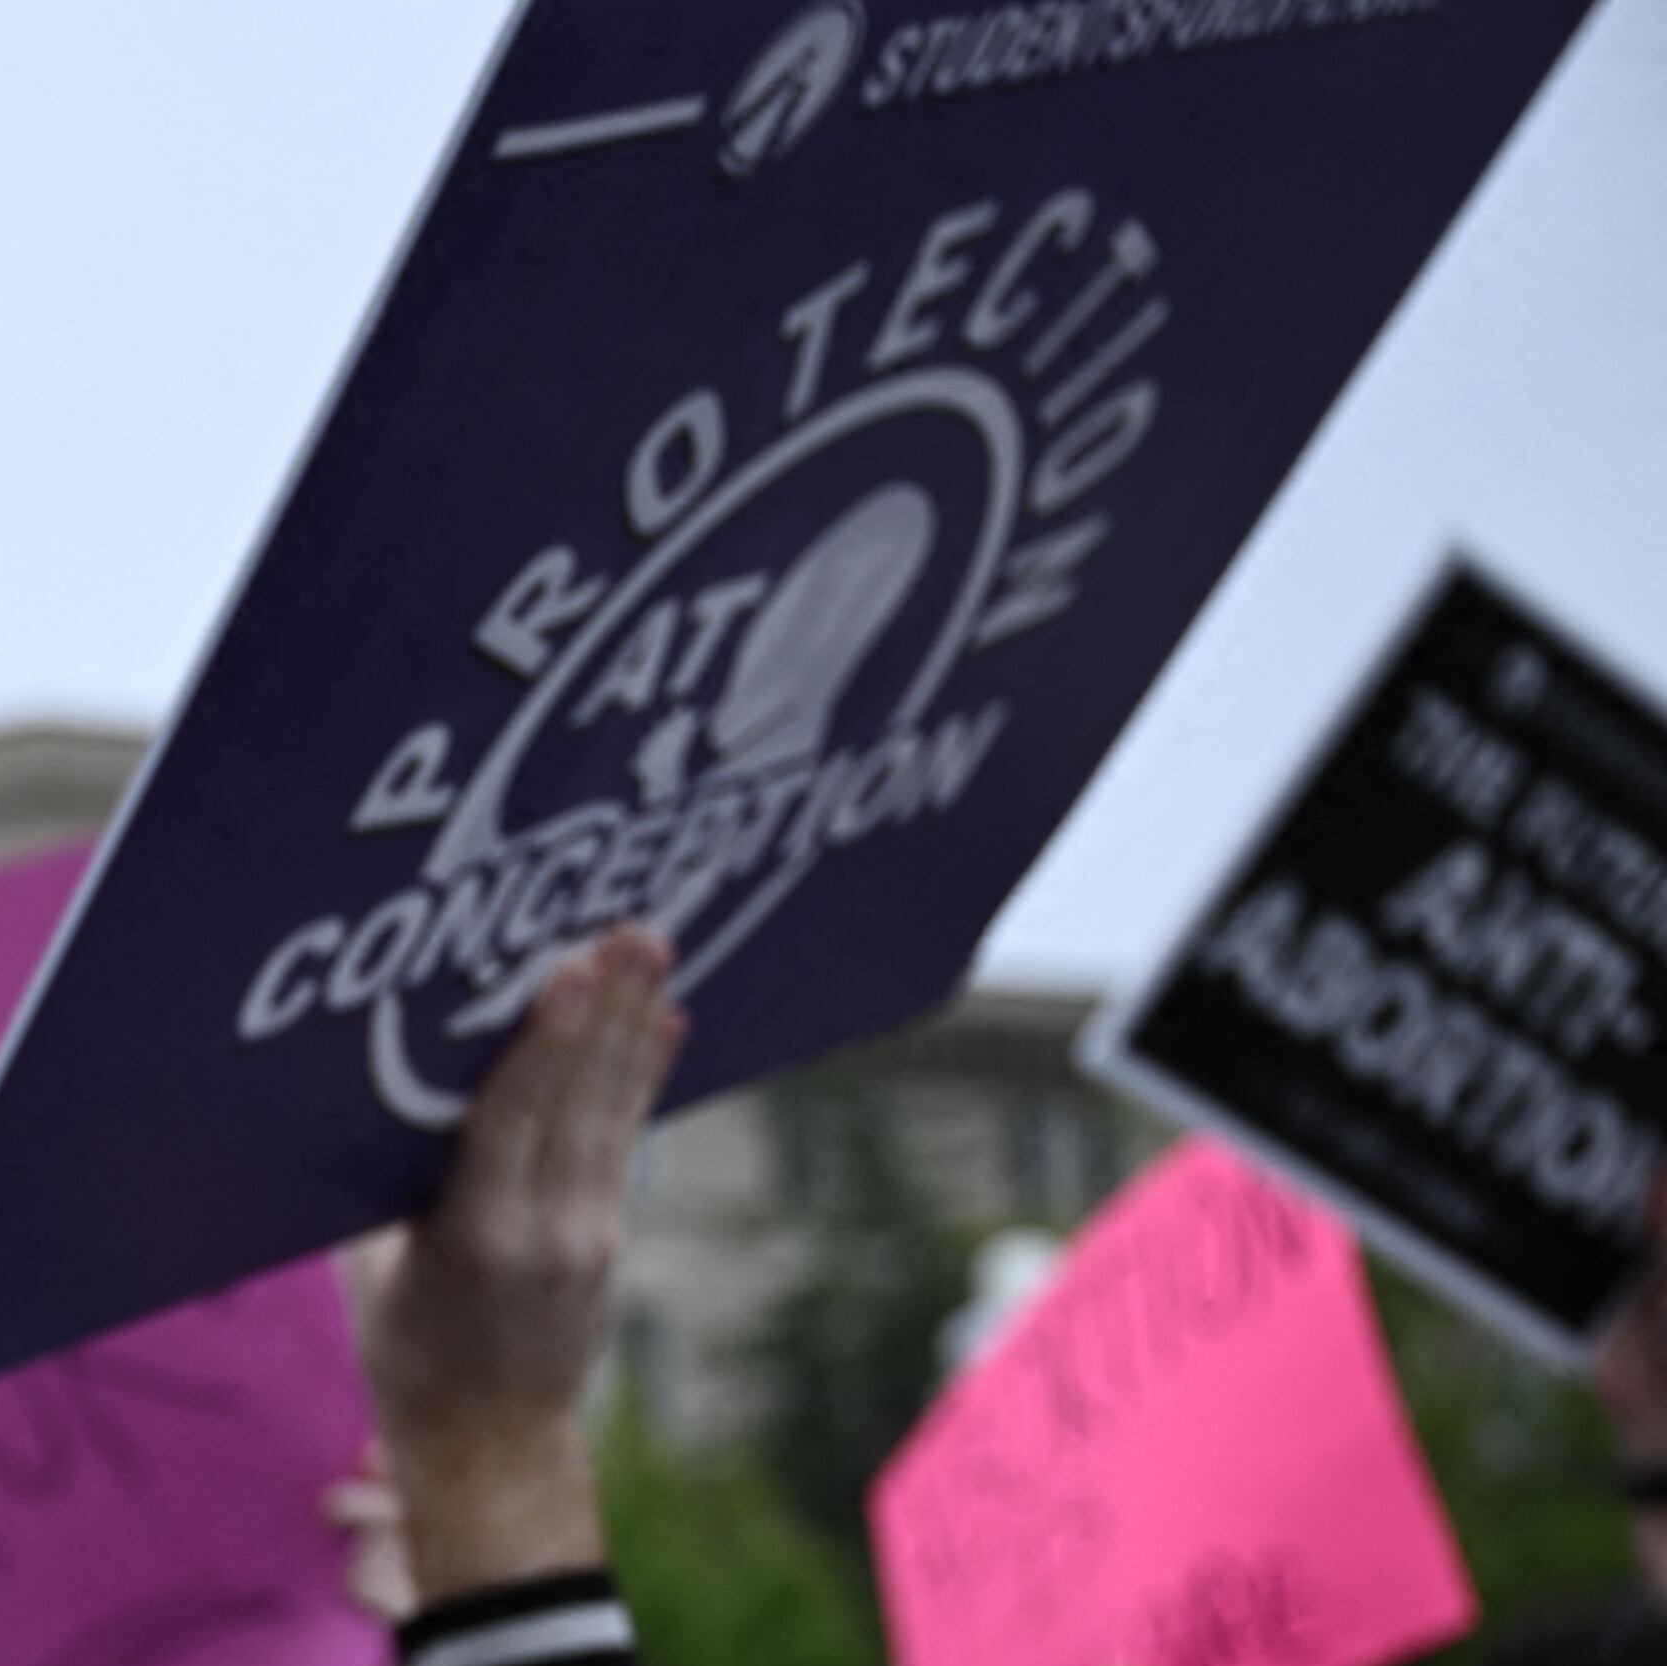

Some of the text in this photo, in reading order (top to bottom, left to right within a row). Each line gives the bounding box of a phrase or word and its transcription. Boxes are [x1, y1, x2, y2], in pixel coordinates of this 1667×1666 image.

[345, 186, 1171, 838] PROTECTION
[569, 571, 769, 730] AT
[235, 698, 1014, 1044] CONCEPTION
